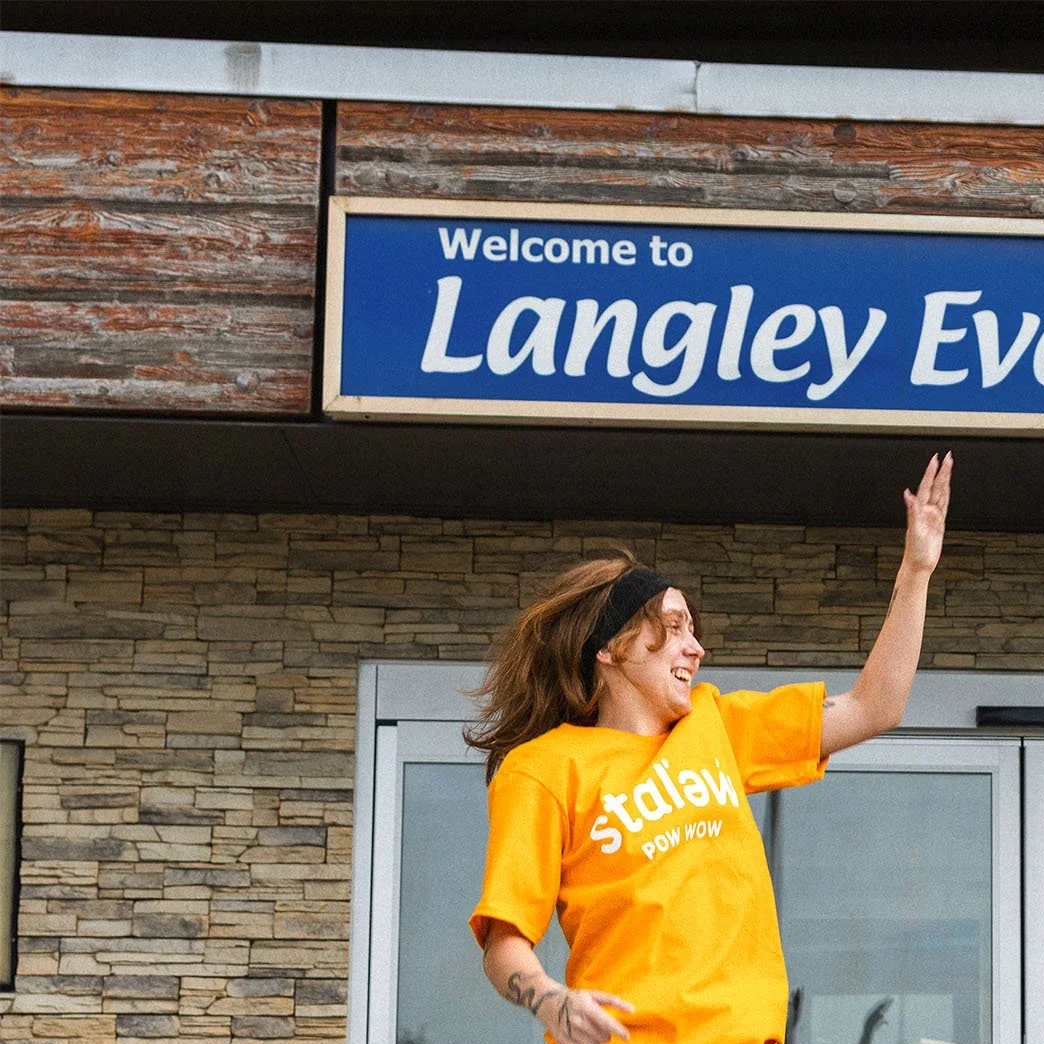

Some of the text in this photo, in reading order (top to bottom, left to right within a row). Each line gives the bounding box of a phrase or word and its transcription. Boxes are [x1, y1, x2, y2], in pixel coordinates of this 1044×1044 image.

[438, 227, 693, 267] Welcome to
[420, 276, 887, 401] Langley
[641, 820, 723, 861] POW WOW
